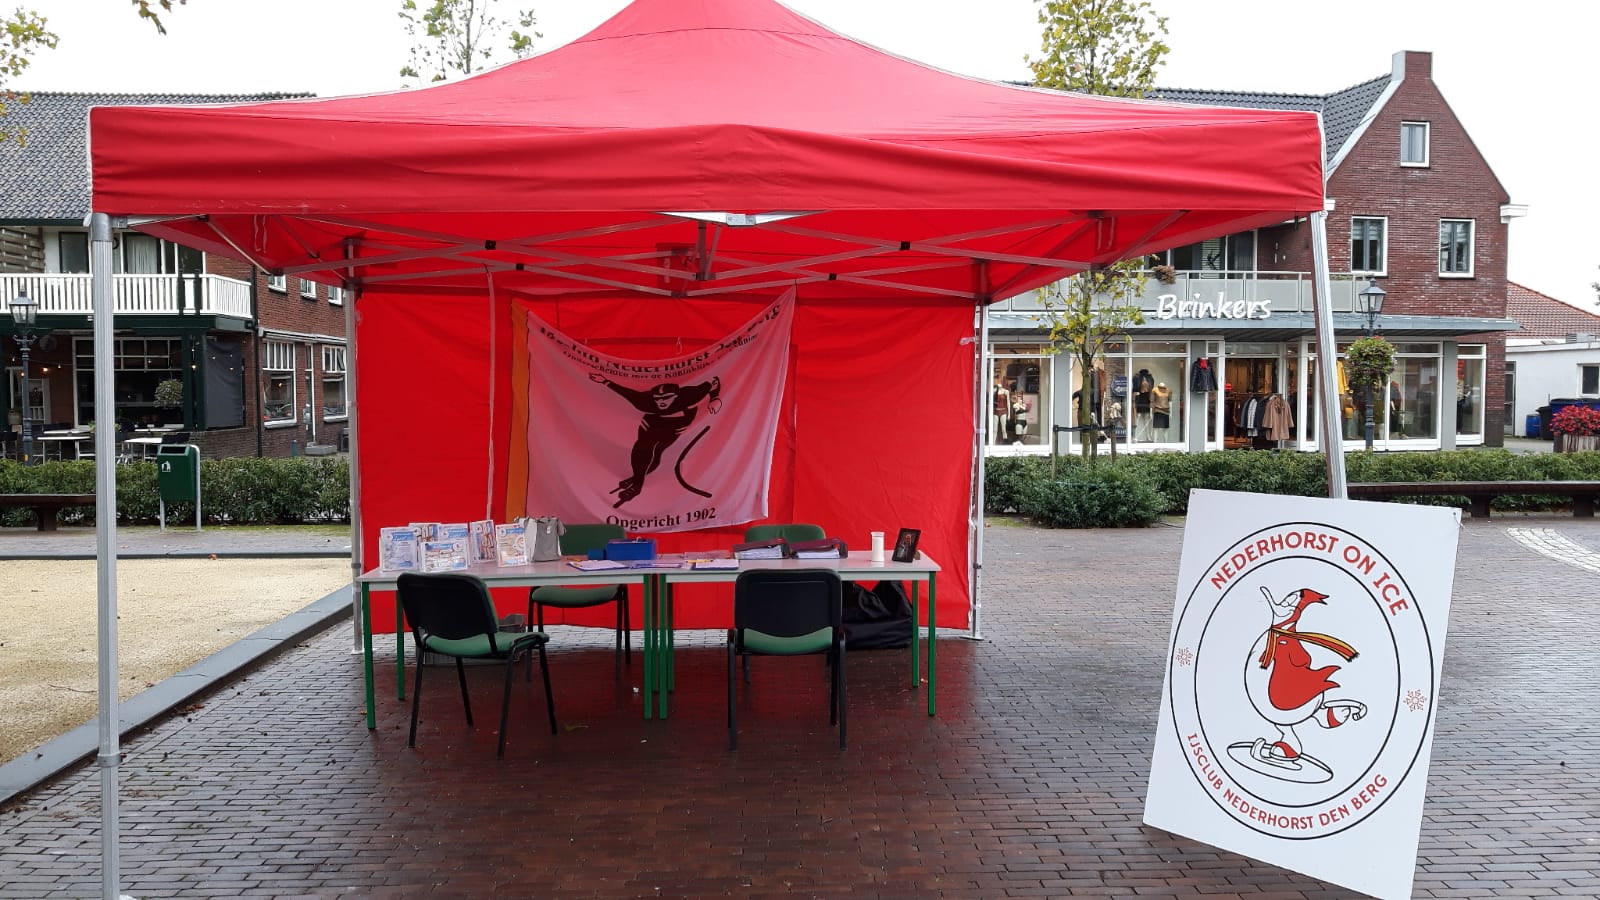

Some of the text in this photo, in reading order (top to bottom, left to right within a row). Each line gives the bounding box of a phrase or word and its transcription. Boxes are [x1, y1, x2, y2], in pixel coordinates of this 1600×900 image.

[1157, 291, 1272, 320] Brinkers
[606, 507, 717, 531] Opgericht 1902
[1211, 531, 1408, 617] NEDERHORST ON ICE
[1187, 732, 1388, 830] IJSCLUB NEDERHORST DEN BERG
